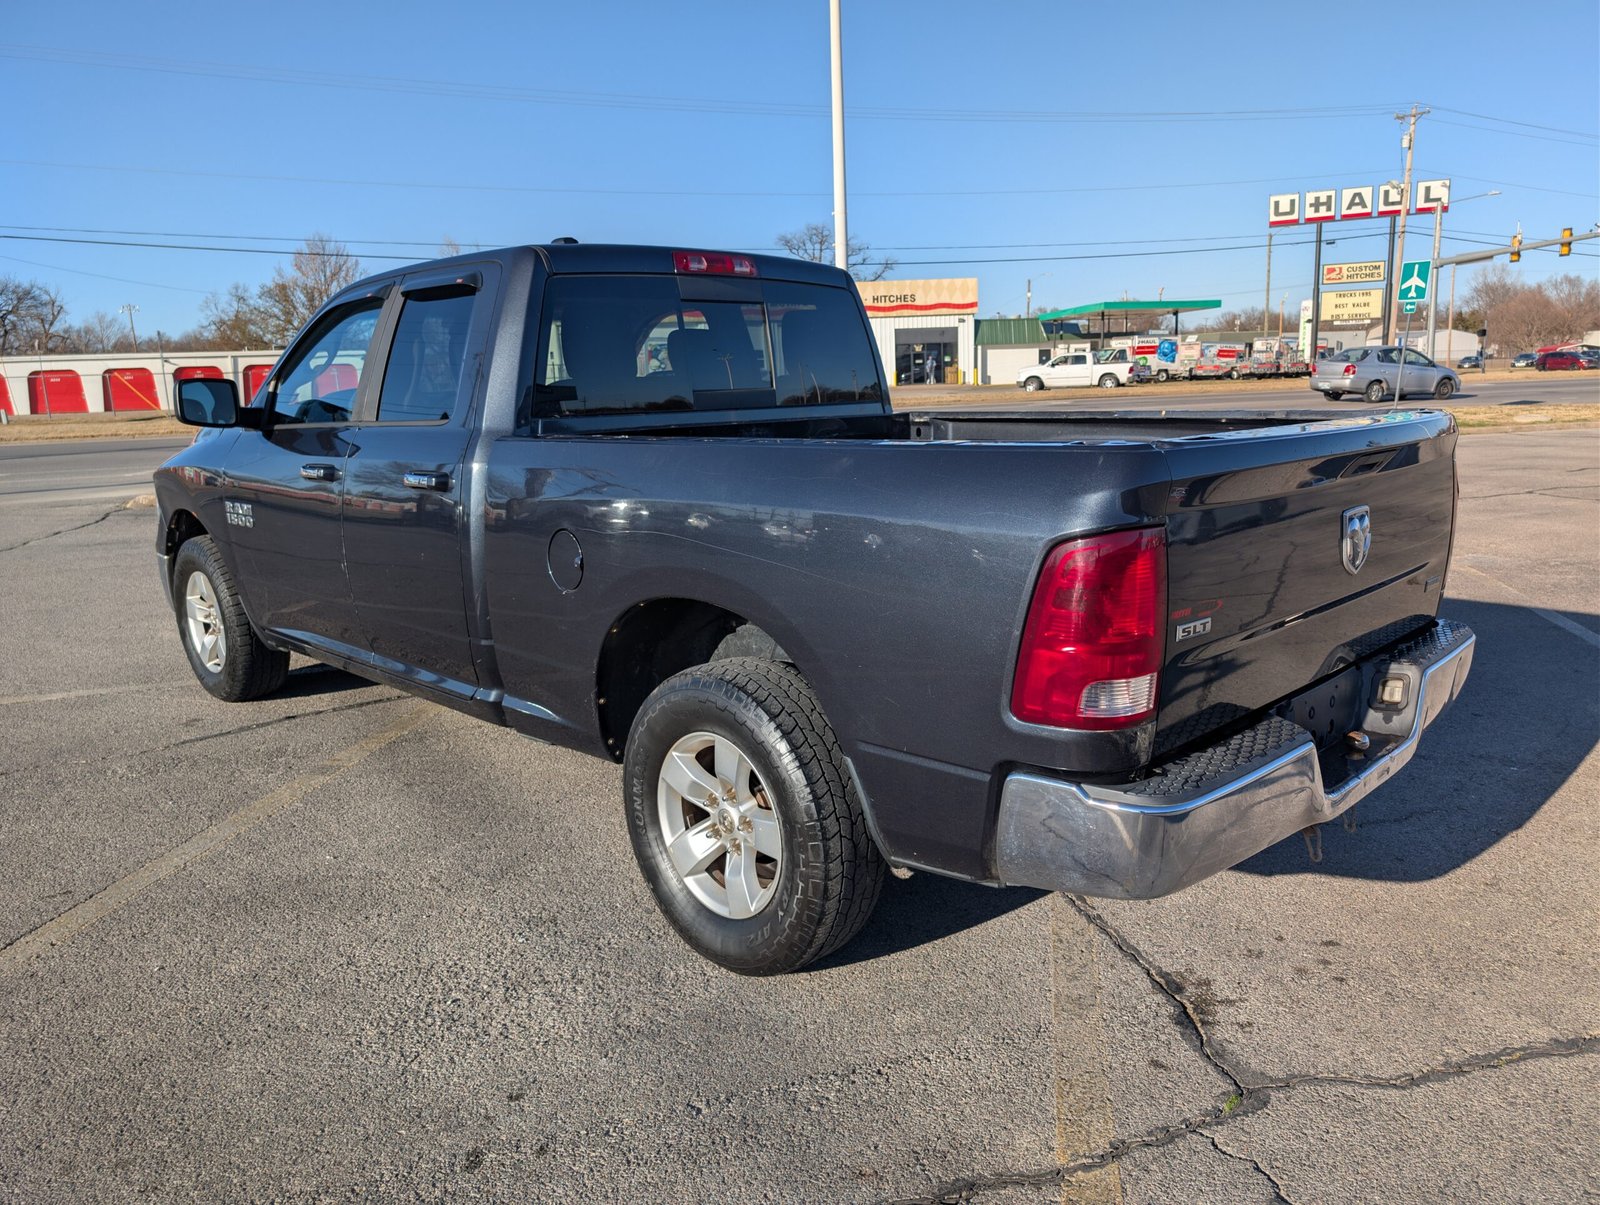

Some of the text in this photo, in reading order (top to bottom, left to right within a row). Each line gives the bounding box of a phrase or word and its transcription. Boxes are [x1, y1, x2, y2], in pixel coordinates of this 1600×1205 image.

[1346, 264, 1381, 273] CUSTOM
[1346, 271, 1382, 280] HITCHES
[872, 293, 917, 304] HITCHES
[224, 500, 253, 516] RAM
[225, 512, 254, 529] 1500
[1180, 620, 1210, 638] SLT
